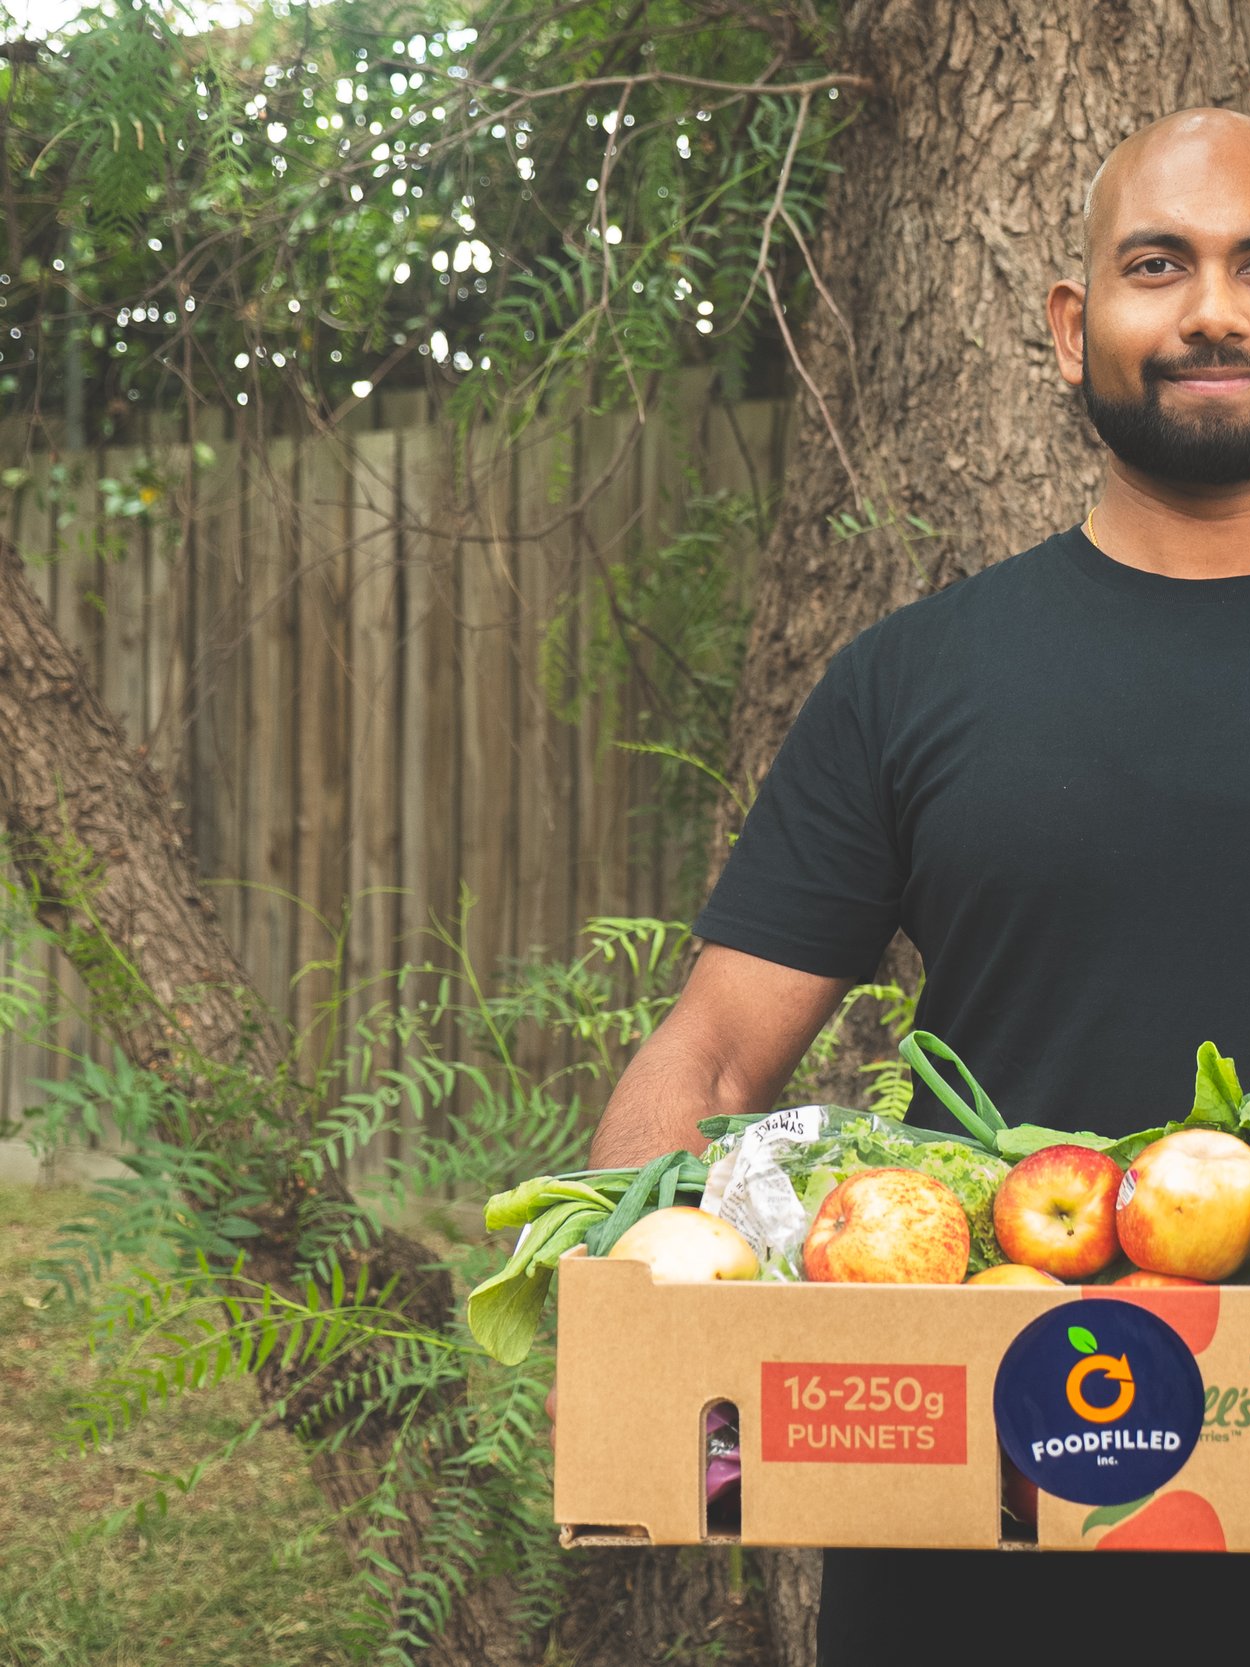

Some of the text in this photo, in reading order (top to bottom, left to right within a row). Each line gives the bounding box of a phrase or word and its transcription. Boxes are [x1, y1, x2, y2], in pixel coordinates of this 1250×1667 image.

[783, 1375, 945, 1420] 16-250g
[787, 1423, 936, 1451] PUNNETS
[1031, 1429, 1181, 1462] FOODFILLED
